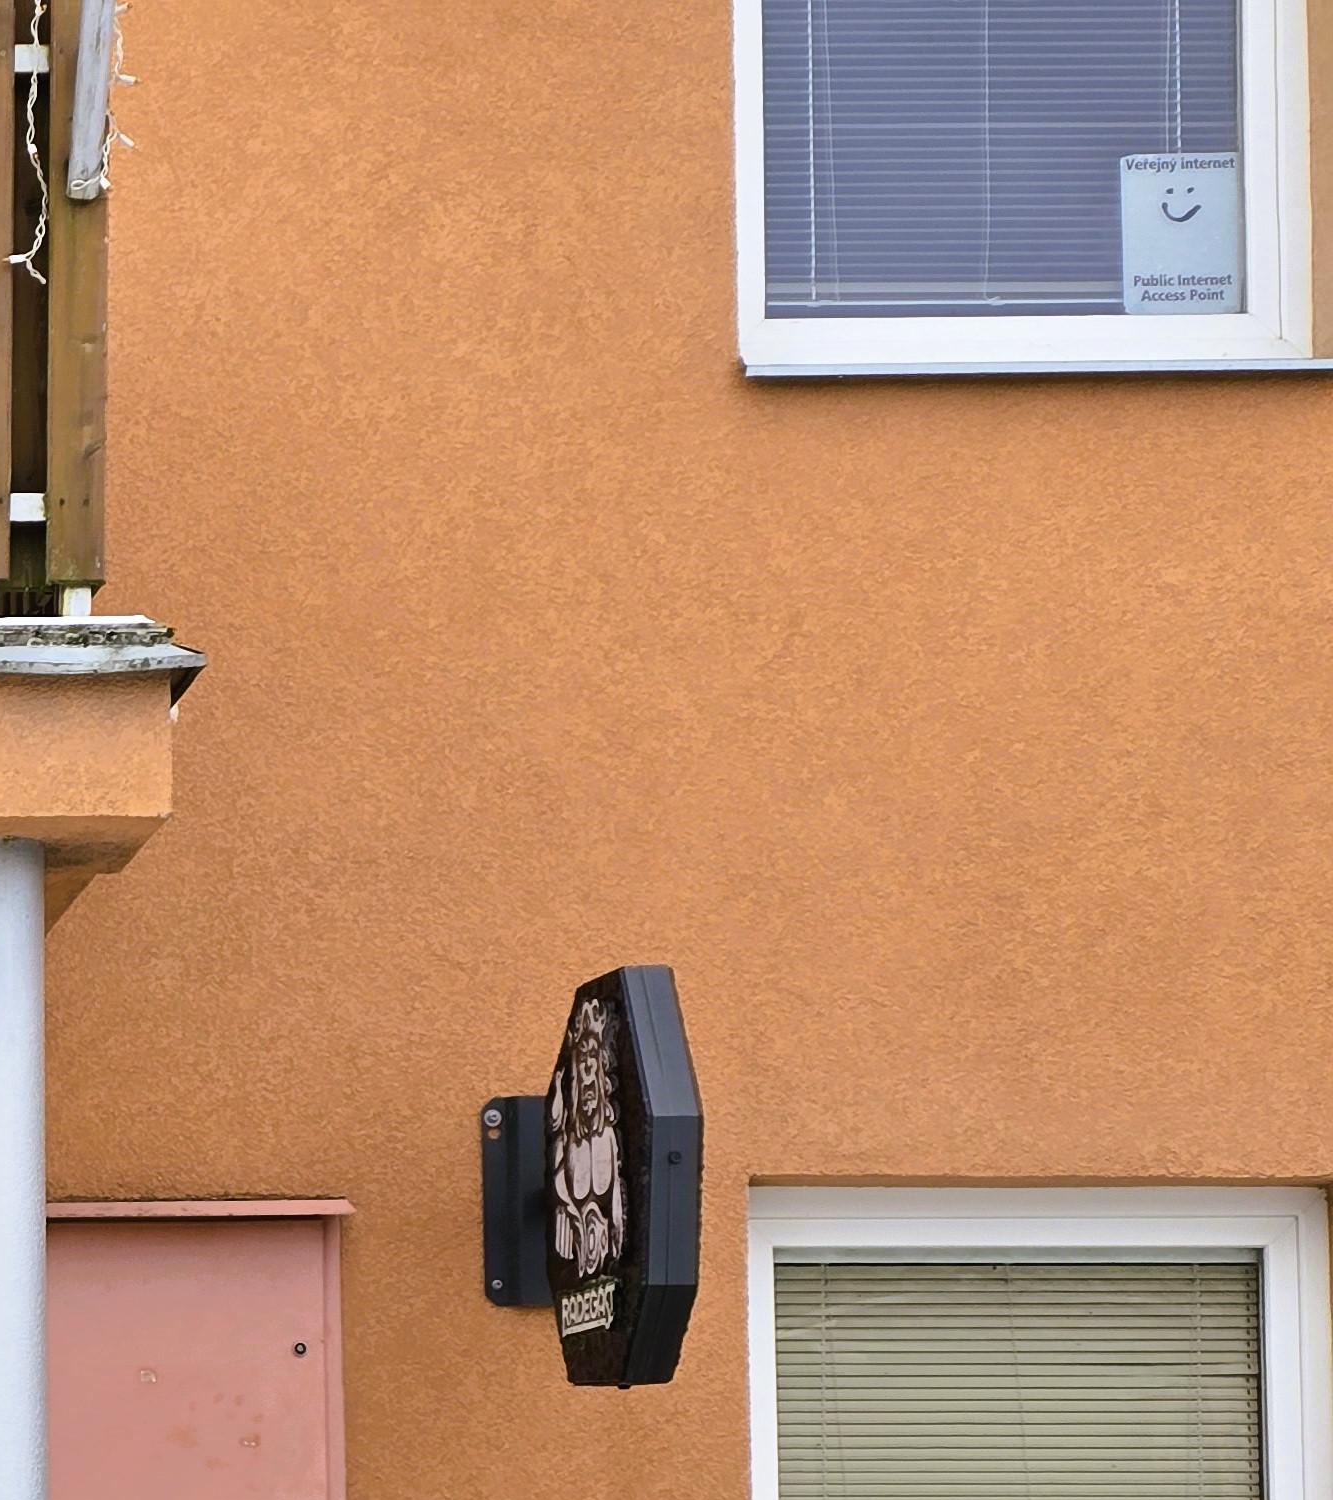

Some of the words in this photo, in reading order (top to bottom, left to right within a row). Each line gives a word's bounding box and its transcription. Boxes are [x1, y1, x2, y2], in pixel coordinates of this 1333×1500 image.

[1126, 157, 1177, 173] Veřejný
[1181, 157, 1236, 170] internet
[1133, 274, 1174, 286] Public
[1178, 274, 1233, 286] Internet
[1141, 289, 1186, 302] Access
[1190, 288, 1225, 301] Point
[561, 1281, 615, 1337] RADEGAST
